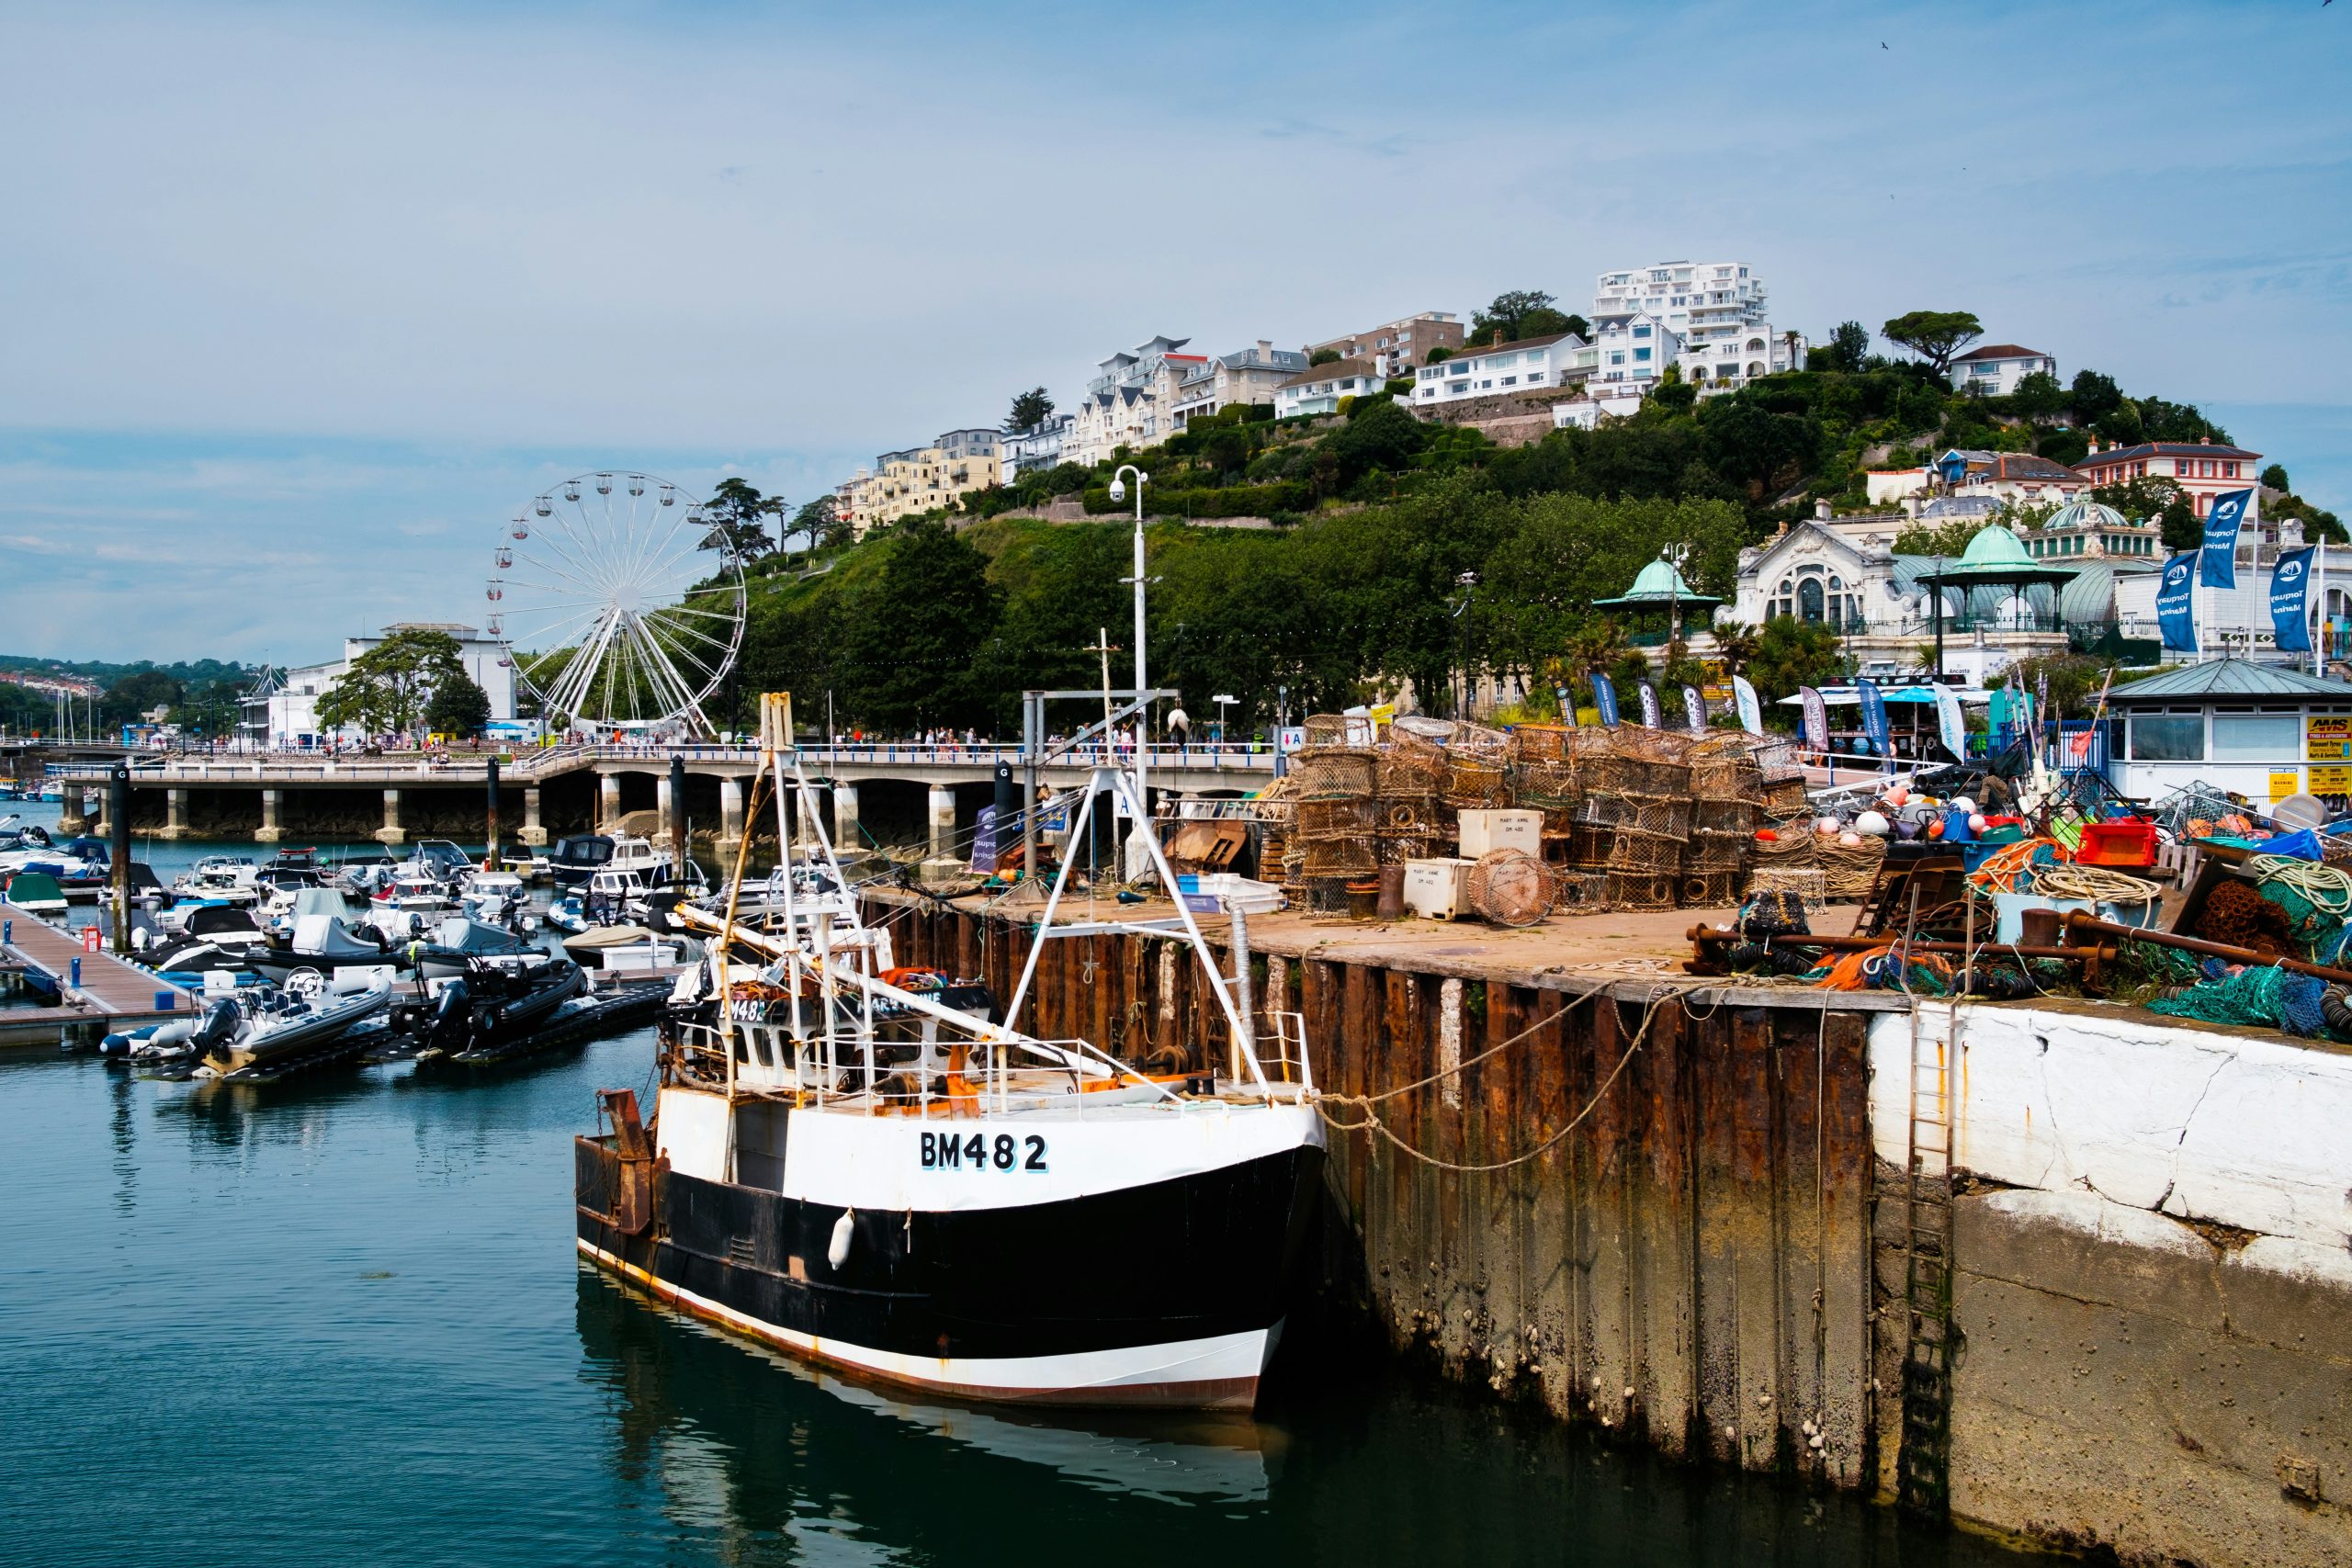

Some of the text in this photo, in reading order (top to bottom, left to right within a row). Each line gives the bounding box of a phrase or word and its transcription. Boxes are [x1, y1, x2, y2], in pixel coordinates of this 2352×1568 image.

[2310, 719, 2348, 731] AMS
[1293, 734, 1301, 744] A
[119, 771, 126, 779] G
[1001, 768, 1008, 776] G
[1120, 795, 1129, 814] A
[921, 1132, 1048, 1173] BM482
